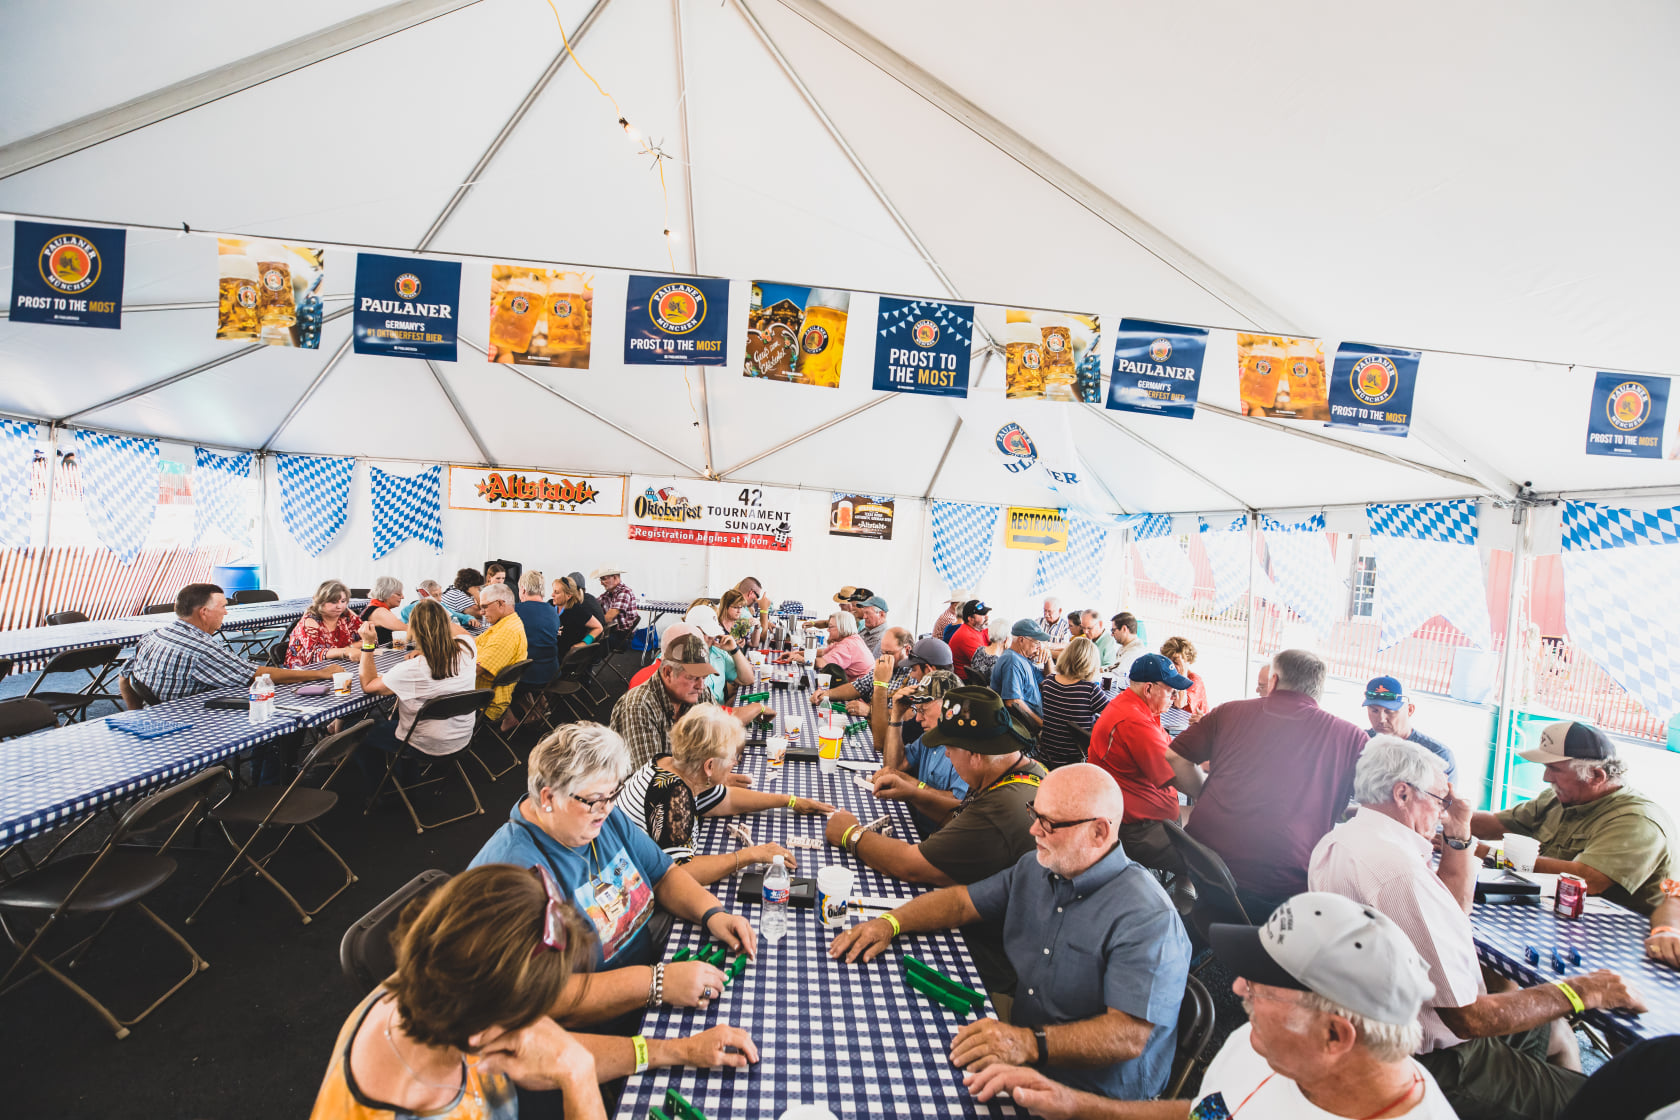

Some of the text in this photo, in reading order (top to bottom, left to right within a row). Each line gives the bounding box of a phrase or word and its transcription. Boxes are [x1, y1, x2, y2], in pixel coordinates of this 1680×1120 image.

[44, 237, 97, 260] PAULANER
[653, 285, 703, 303] PAULANER
[18, 296, 116, 313] PROST TO THE MOST
[360, 297, 452, 319] PAULANER
[385, 320, 425, 332] GERMANY'S
[630, 338, 722, 351] PROST TO THE MOST
[890, 348, 957, 370] PROST TO
[1354, 355, 1395, 377] PAULANER
[889, 365, 957, 387] THE MOST
[1118, 359, 1195, 381] PAULANER
[1332, 405, 1407, 424] PROST TO THE MOST
[1590, 433, 1658, 447] PROST TO THE MOST
[485, 473, 587, 504] Altstadt
[738, 488, 762, 507] 42
[501, 500, 576, 511] BREWERY
[634, 495, 703, 522] Oktoberfest
[707, 505, 791, 521] TOURNAMENT
[725, 520, 771, 532] SUNDAY
[1011, 512, 1065, 533] RESTROOMS
[634, 527, 768, 546] Registration begins at Noon
